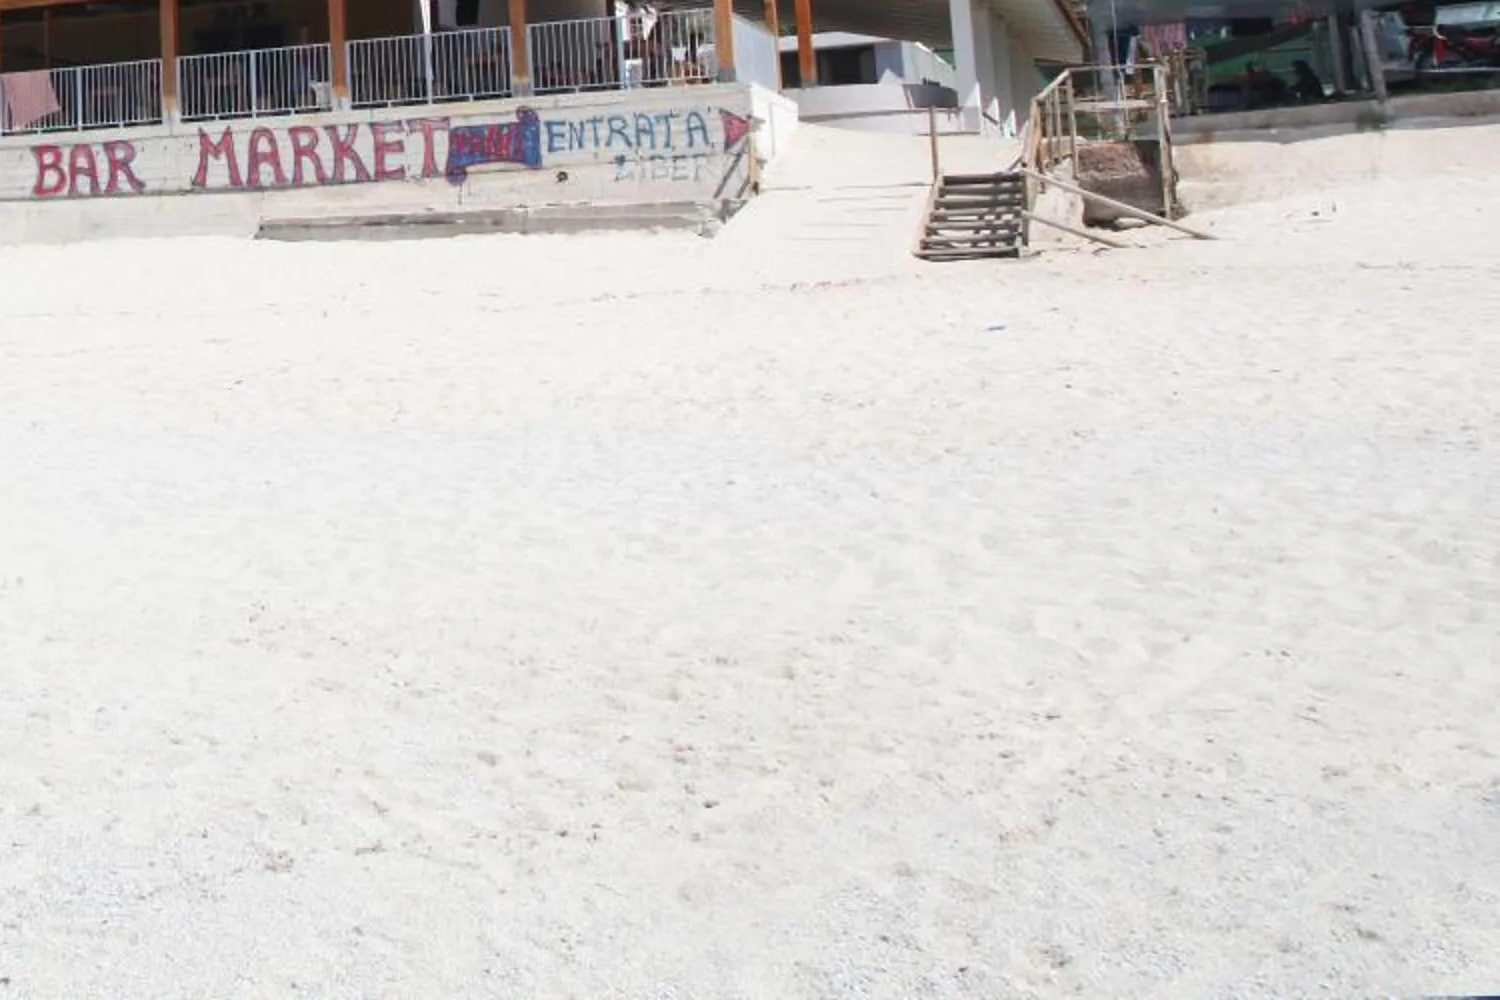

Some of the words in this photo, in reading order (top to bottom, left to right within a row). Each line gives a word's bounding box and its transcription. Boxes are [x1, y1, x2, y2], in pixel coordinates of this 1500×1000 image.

[32, 140, 146, 196] BAR
[191, 116, 450, 188] MARKET
[544, 110, 709, 151] ENTRATA
